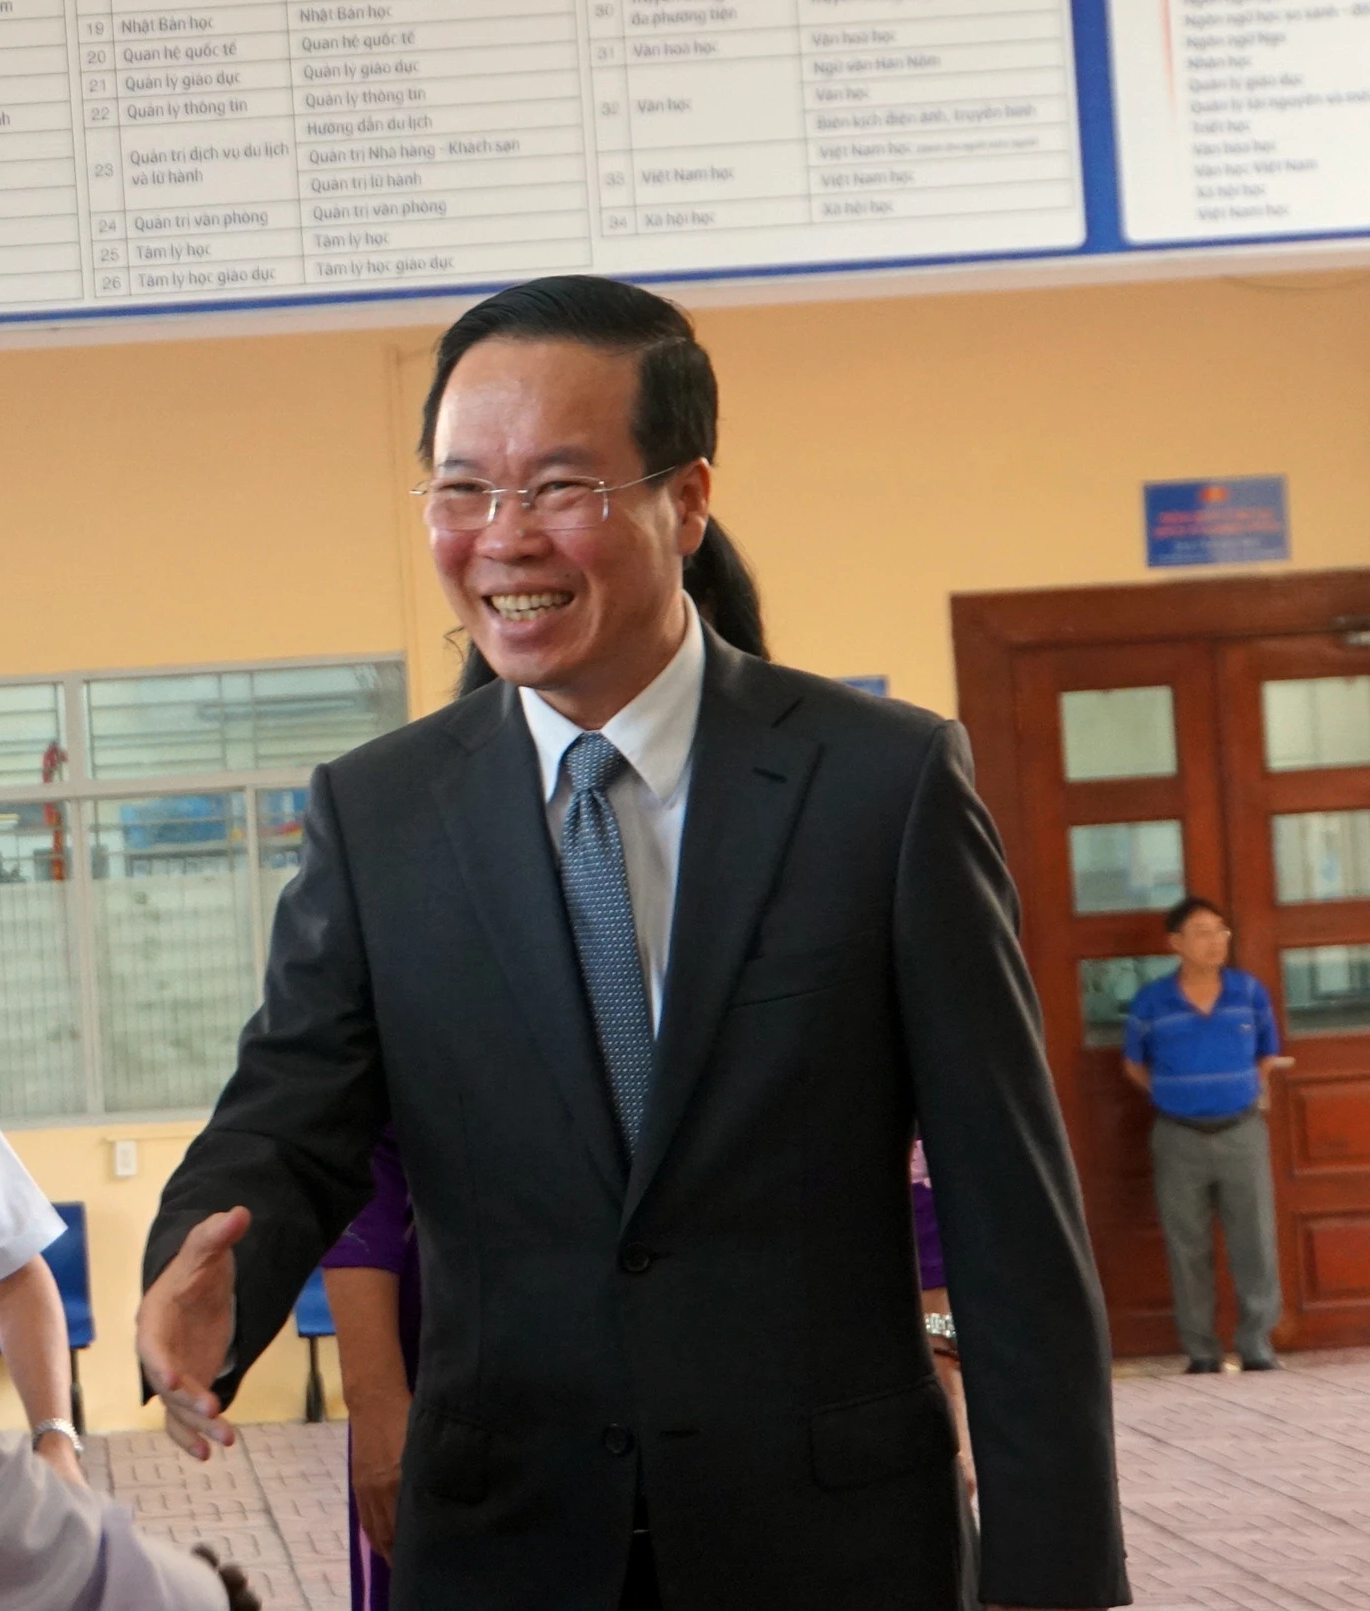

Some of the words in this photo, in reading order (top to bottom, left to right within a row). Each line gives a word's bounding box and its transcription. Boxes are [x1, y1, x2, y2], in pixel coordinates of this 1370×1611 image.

[87, 21, 105, 36] 19
[122, 19, 154, 36] Nhật
[159, 17, 185, 32] Bản
[190, 16, 214, 32] học
[88, 50, 106, 64] 20
[90, 78, 106, 92] 21
[91, 107, 110, 121] 22
[131, 150, 167, 167] Quản
[171, 149, 186, 165] trị
[190, 147, 219, 164] dịch
[223, 149, 240, 162] vụ
[243, 144, 261, 158] du
[265, 142, 290, 159] lịch
[94, 164, 114, 178] 23
[99, 220, 116, 234] 24
[100, 248, 119, 262] 25
[102, 276, 122, 290] 26
